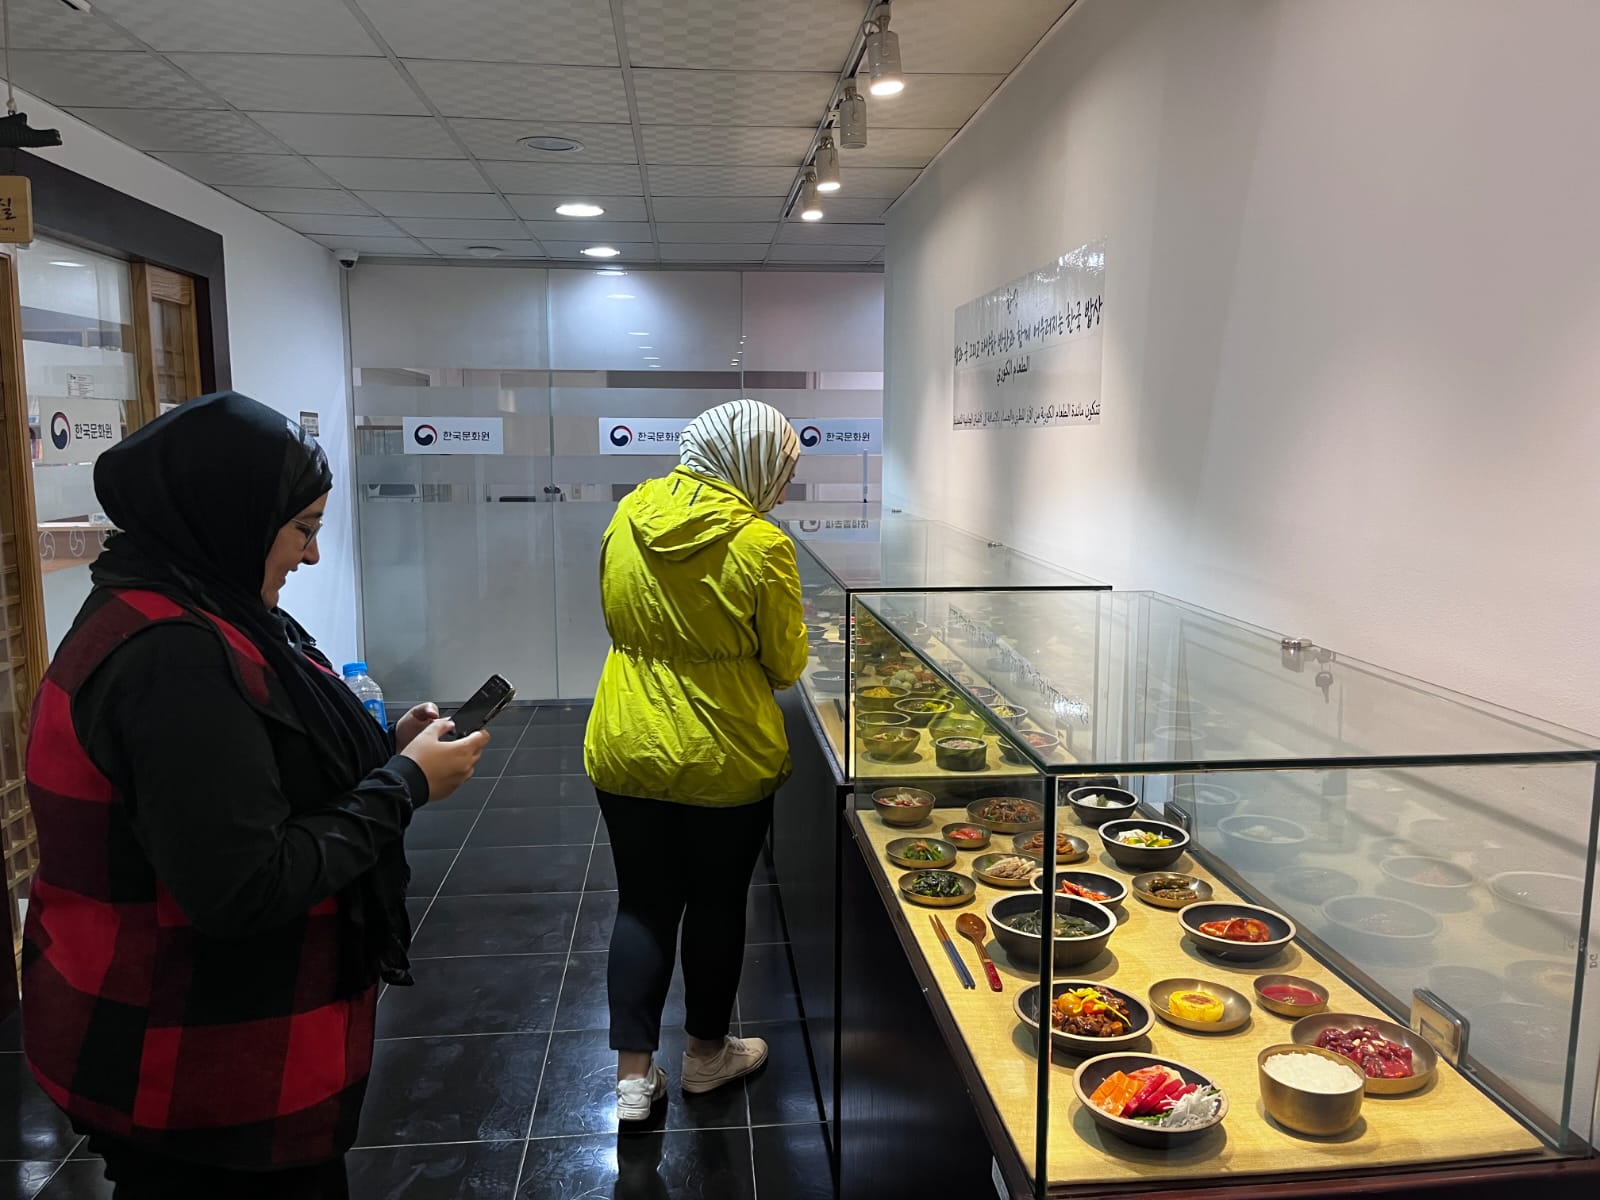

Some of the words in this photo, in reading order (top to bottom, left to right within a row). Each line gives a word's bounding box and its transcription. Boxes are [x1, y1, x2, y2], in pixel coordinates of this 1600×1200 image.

[969, 340, 980, 359] 그리고
[1017, 320, 1031, 348] 함께
[1033, 310, 1064, 343] 어우러지는
[1066, 301, 1081, 334] 한국
[1085, 295, 1103, 328] 밥상
[997, 360, 1012, 386] الكوري
[1013, 356, 1029, 384] الطعام
[74, 423, 112, 439] 한국문화원
[443, 431, 490, 441] 한국문화원
[826, 432, 870, 442] 한국문화원
